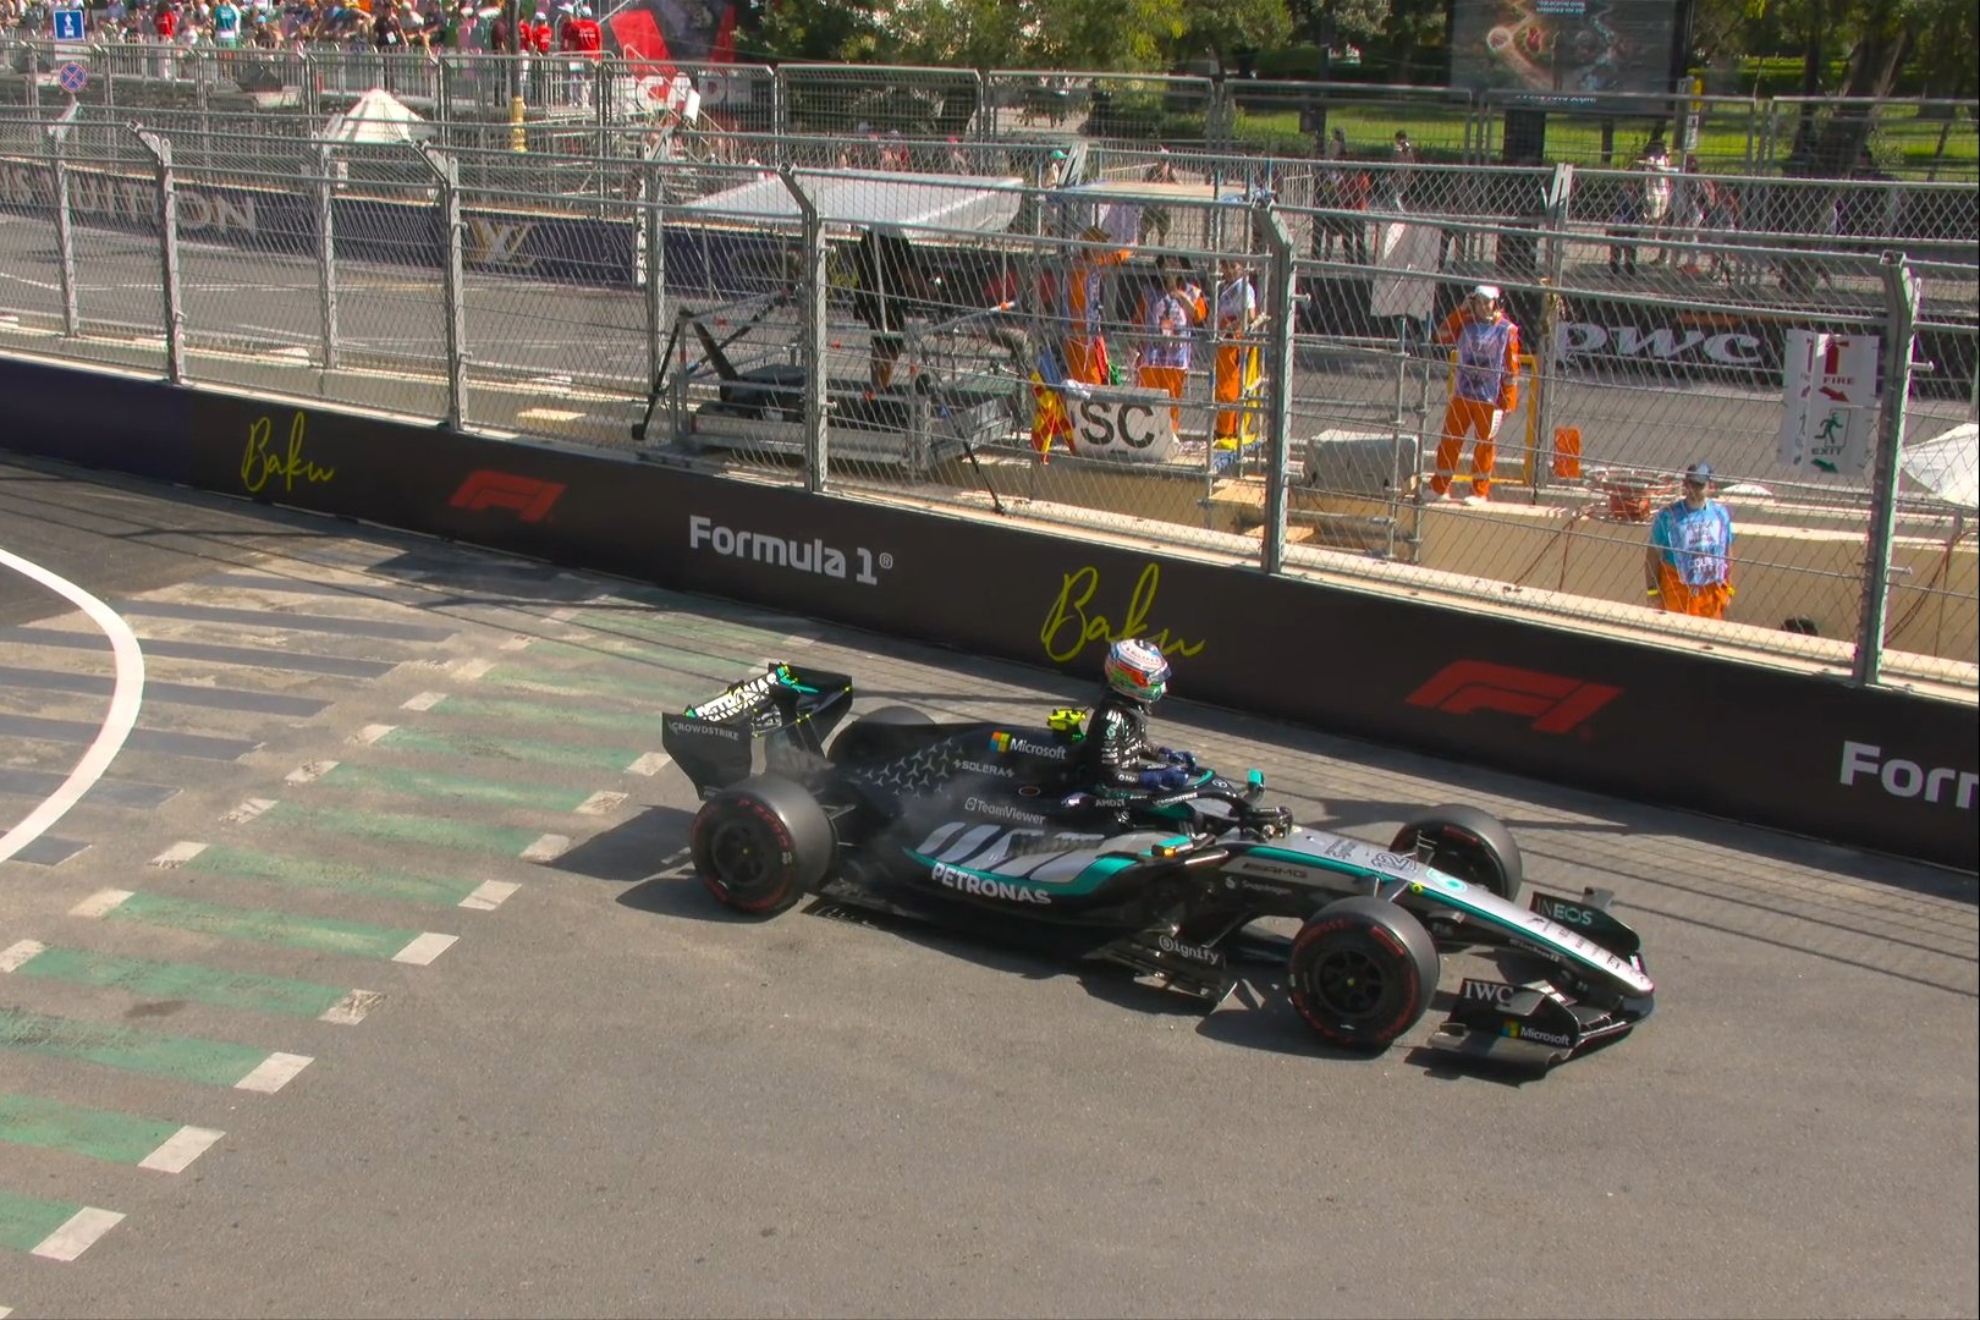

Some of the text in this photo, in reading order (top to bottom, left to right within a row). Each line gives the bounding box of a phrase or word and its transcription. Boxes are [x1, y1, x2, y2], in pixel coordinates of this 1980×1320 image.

[1823, 376, 1854, 385] FIRE
[1080, 400, 1155, 449] SC
[241, 411, 335, 491] Baku
[1811, 447, 1841, 456] EXIT
[689, 514, 846, 579] Formula
[1041, 563, 1206, 663] Baku
[671, 721, 739, 741] CROWDSTRIKE
[1010, 738, 1067, 760] Microsoft
[962, 760, 1007, 776] SOLERA
[978, 800, 1046, 825] TeamViewer
[931, 861, 1052, 904] PETRONAS
[1535, 898, 1594, 926] INEOS
[1464, 980, 1514, 1003] IWC
[1520, 1026, 1570, 1046] Microsoft
